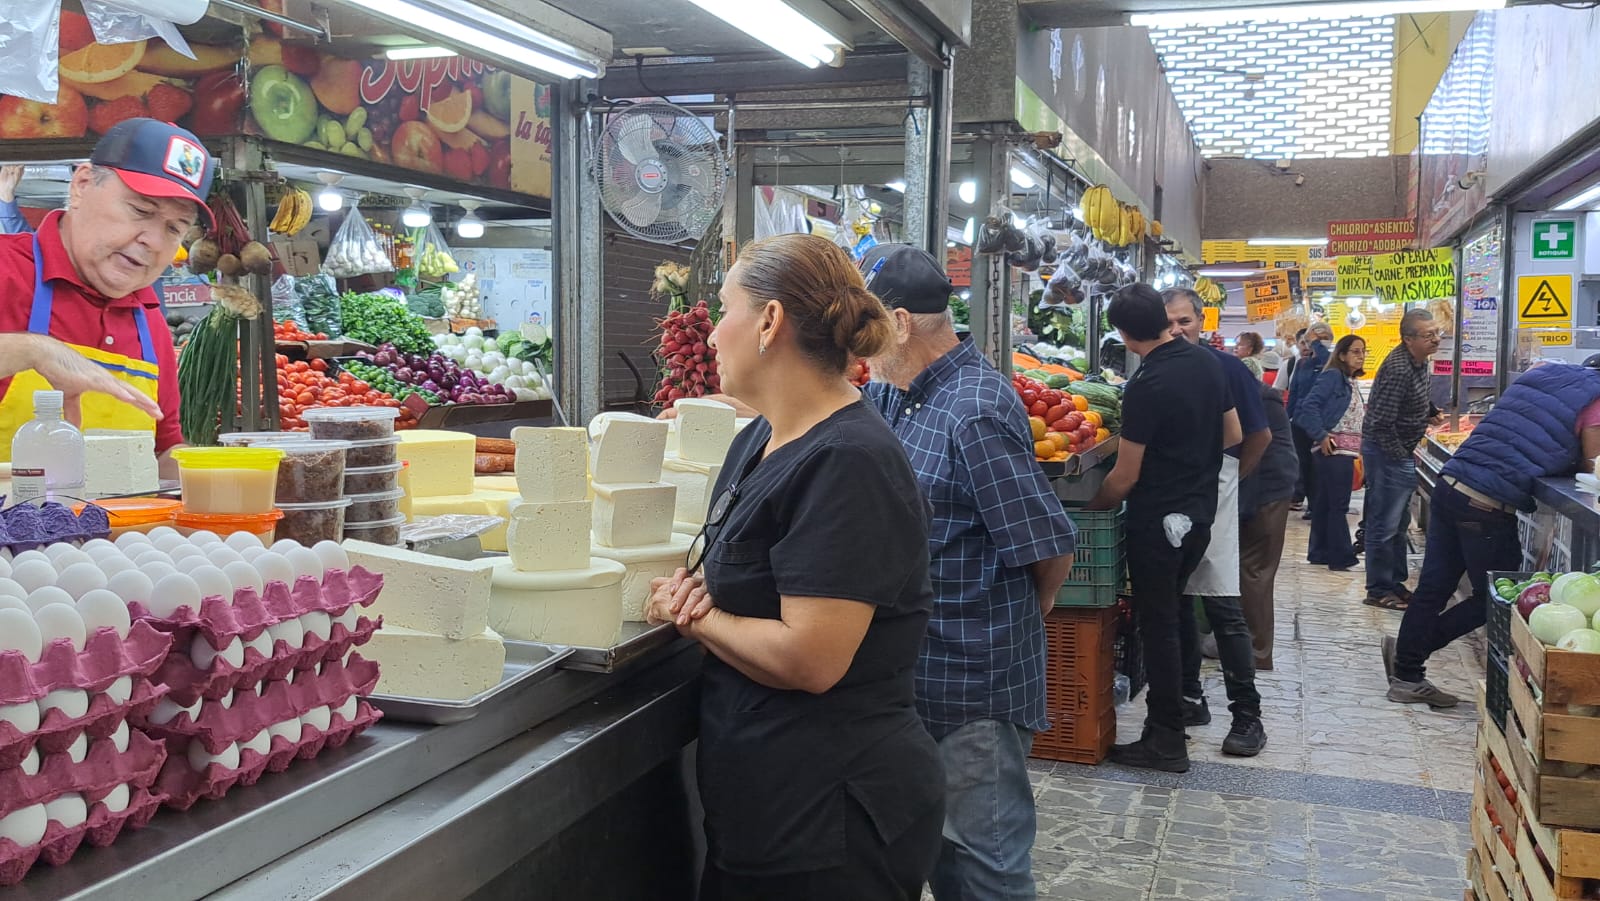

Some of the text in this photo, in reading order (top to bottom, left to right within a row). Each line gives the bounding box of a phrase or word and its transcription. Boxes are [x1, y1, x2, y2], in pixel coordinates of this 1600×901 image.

[1309, 248, 1322, 258] SUS
[1374, 262, 1456, 281] CARNE PREPARADA
[1343, 276, 1375, 291] MIXTA
[1375, 284, 1400, 301] PARA
[1401, 280, 1432, 300] ASAR
